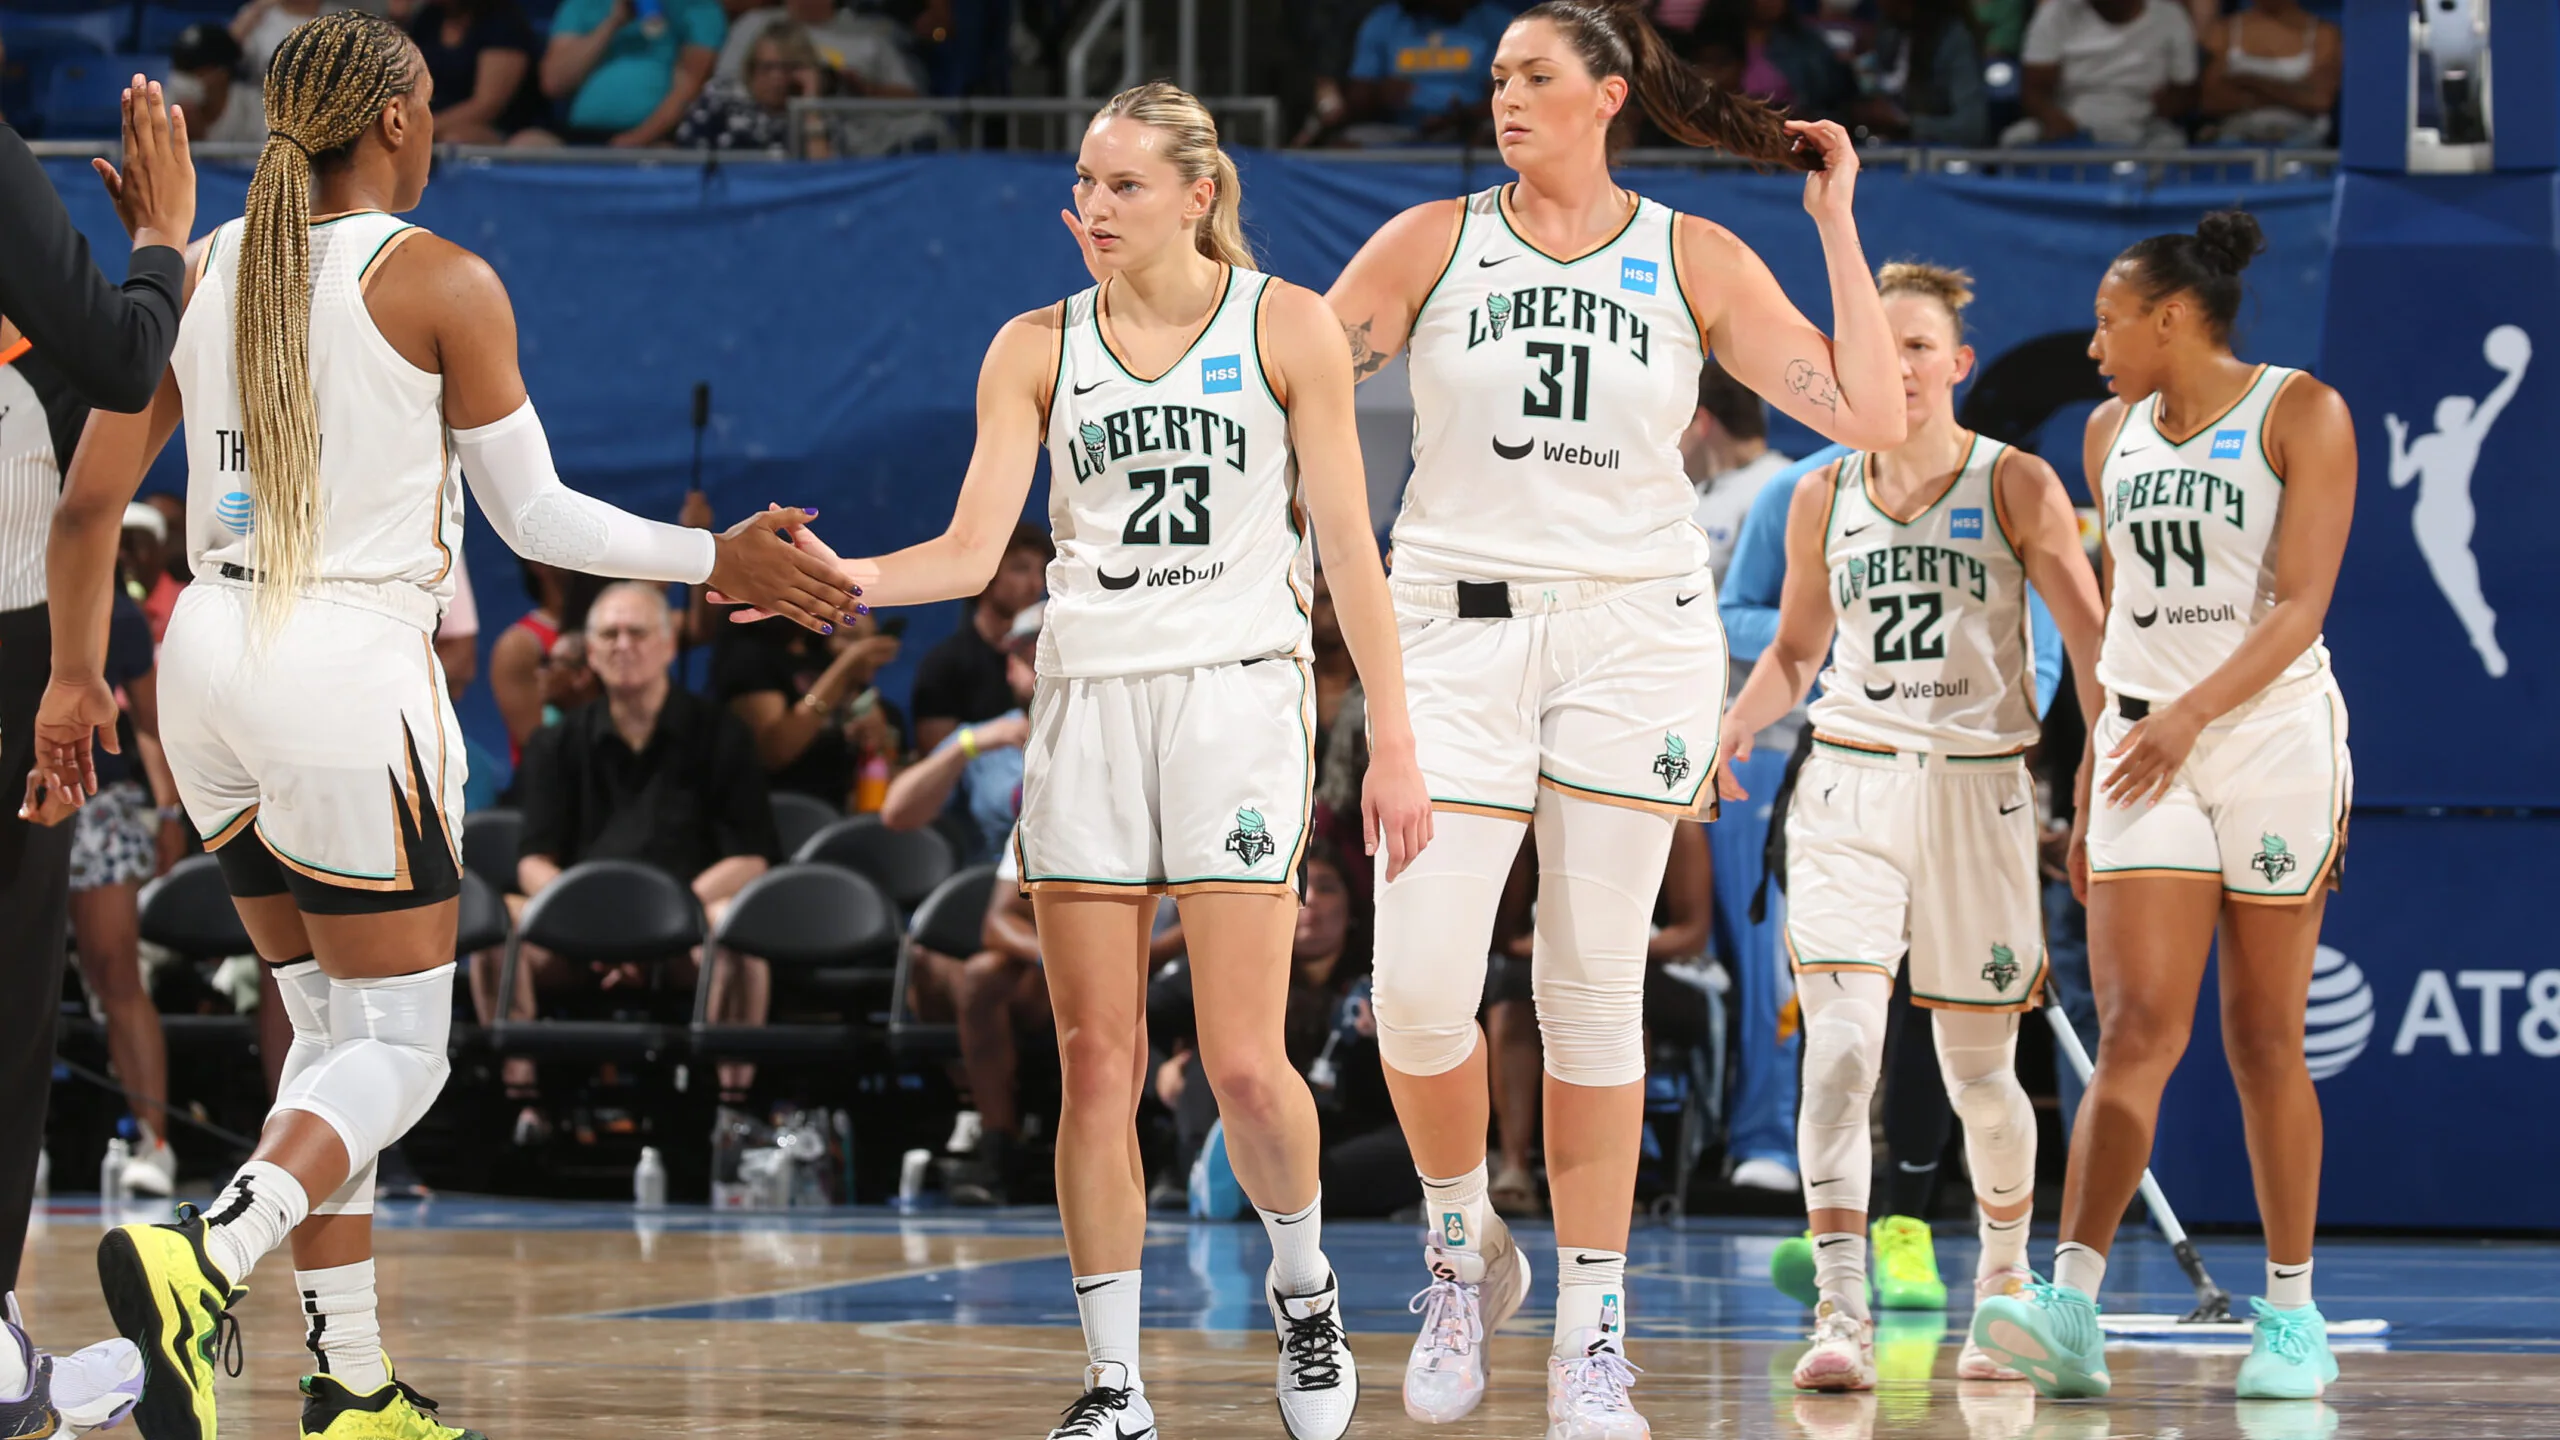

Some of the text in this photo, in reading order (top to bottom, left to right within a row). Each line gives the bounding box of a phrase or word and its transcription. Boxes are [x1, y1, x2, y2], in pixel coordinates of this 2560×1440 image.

[1624, 267, 1655, 283] HSS
[1466, 286, 1649, 368] LIBERTY
[1205, 367, 1238, 382] HSS
[1522, 340, 1591, 422] 31
[1068, 404, 1246, 485] LIBERTY
[1543, 440, 1620, 470] Webull
[2215, 438, 2241, 449] HSS
[1121, 465, 1210, 546] 23
[1952, 517, 1981, 529] HSS
[2129, 520, 2206, 588] 44
[1146, 561, 1224, 587] Webull
[1838, 545, 1987, 610] LIBERTY
[1868, 591, 1945, 664] 22
[2165, 604, 2236, 625] Webull
[1901, 679, 1969, 699] Webull
